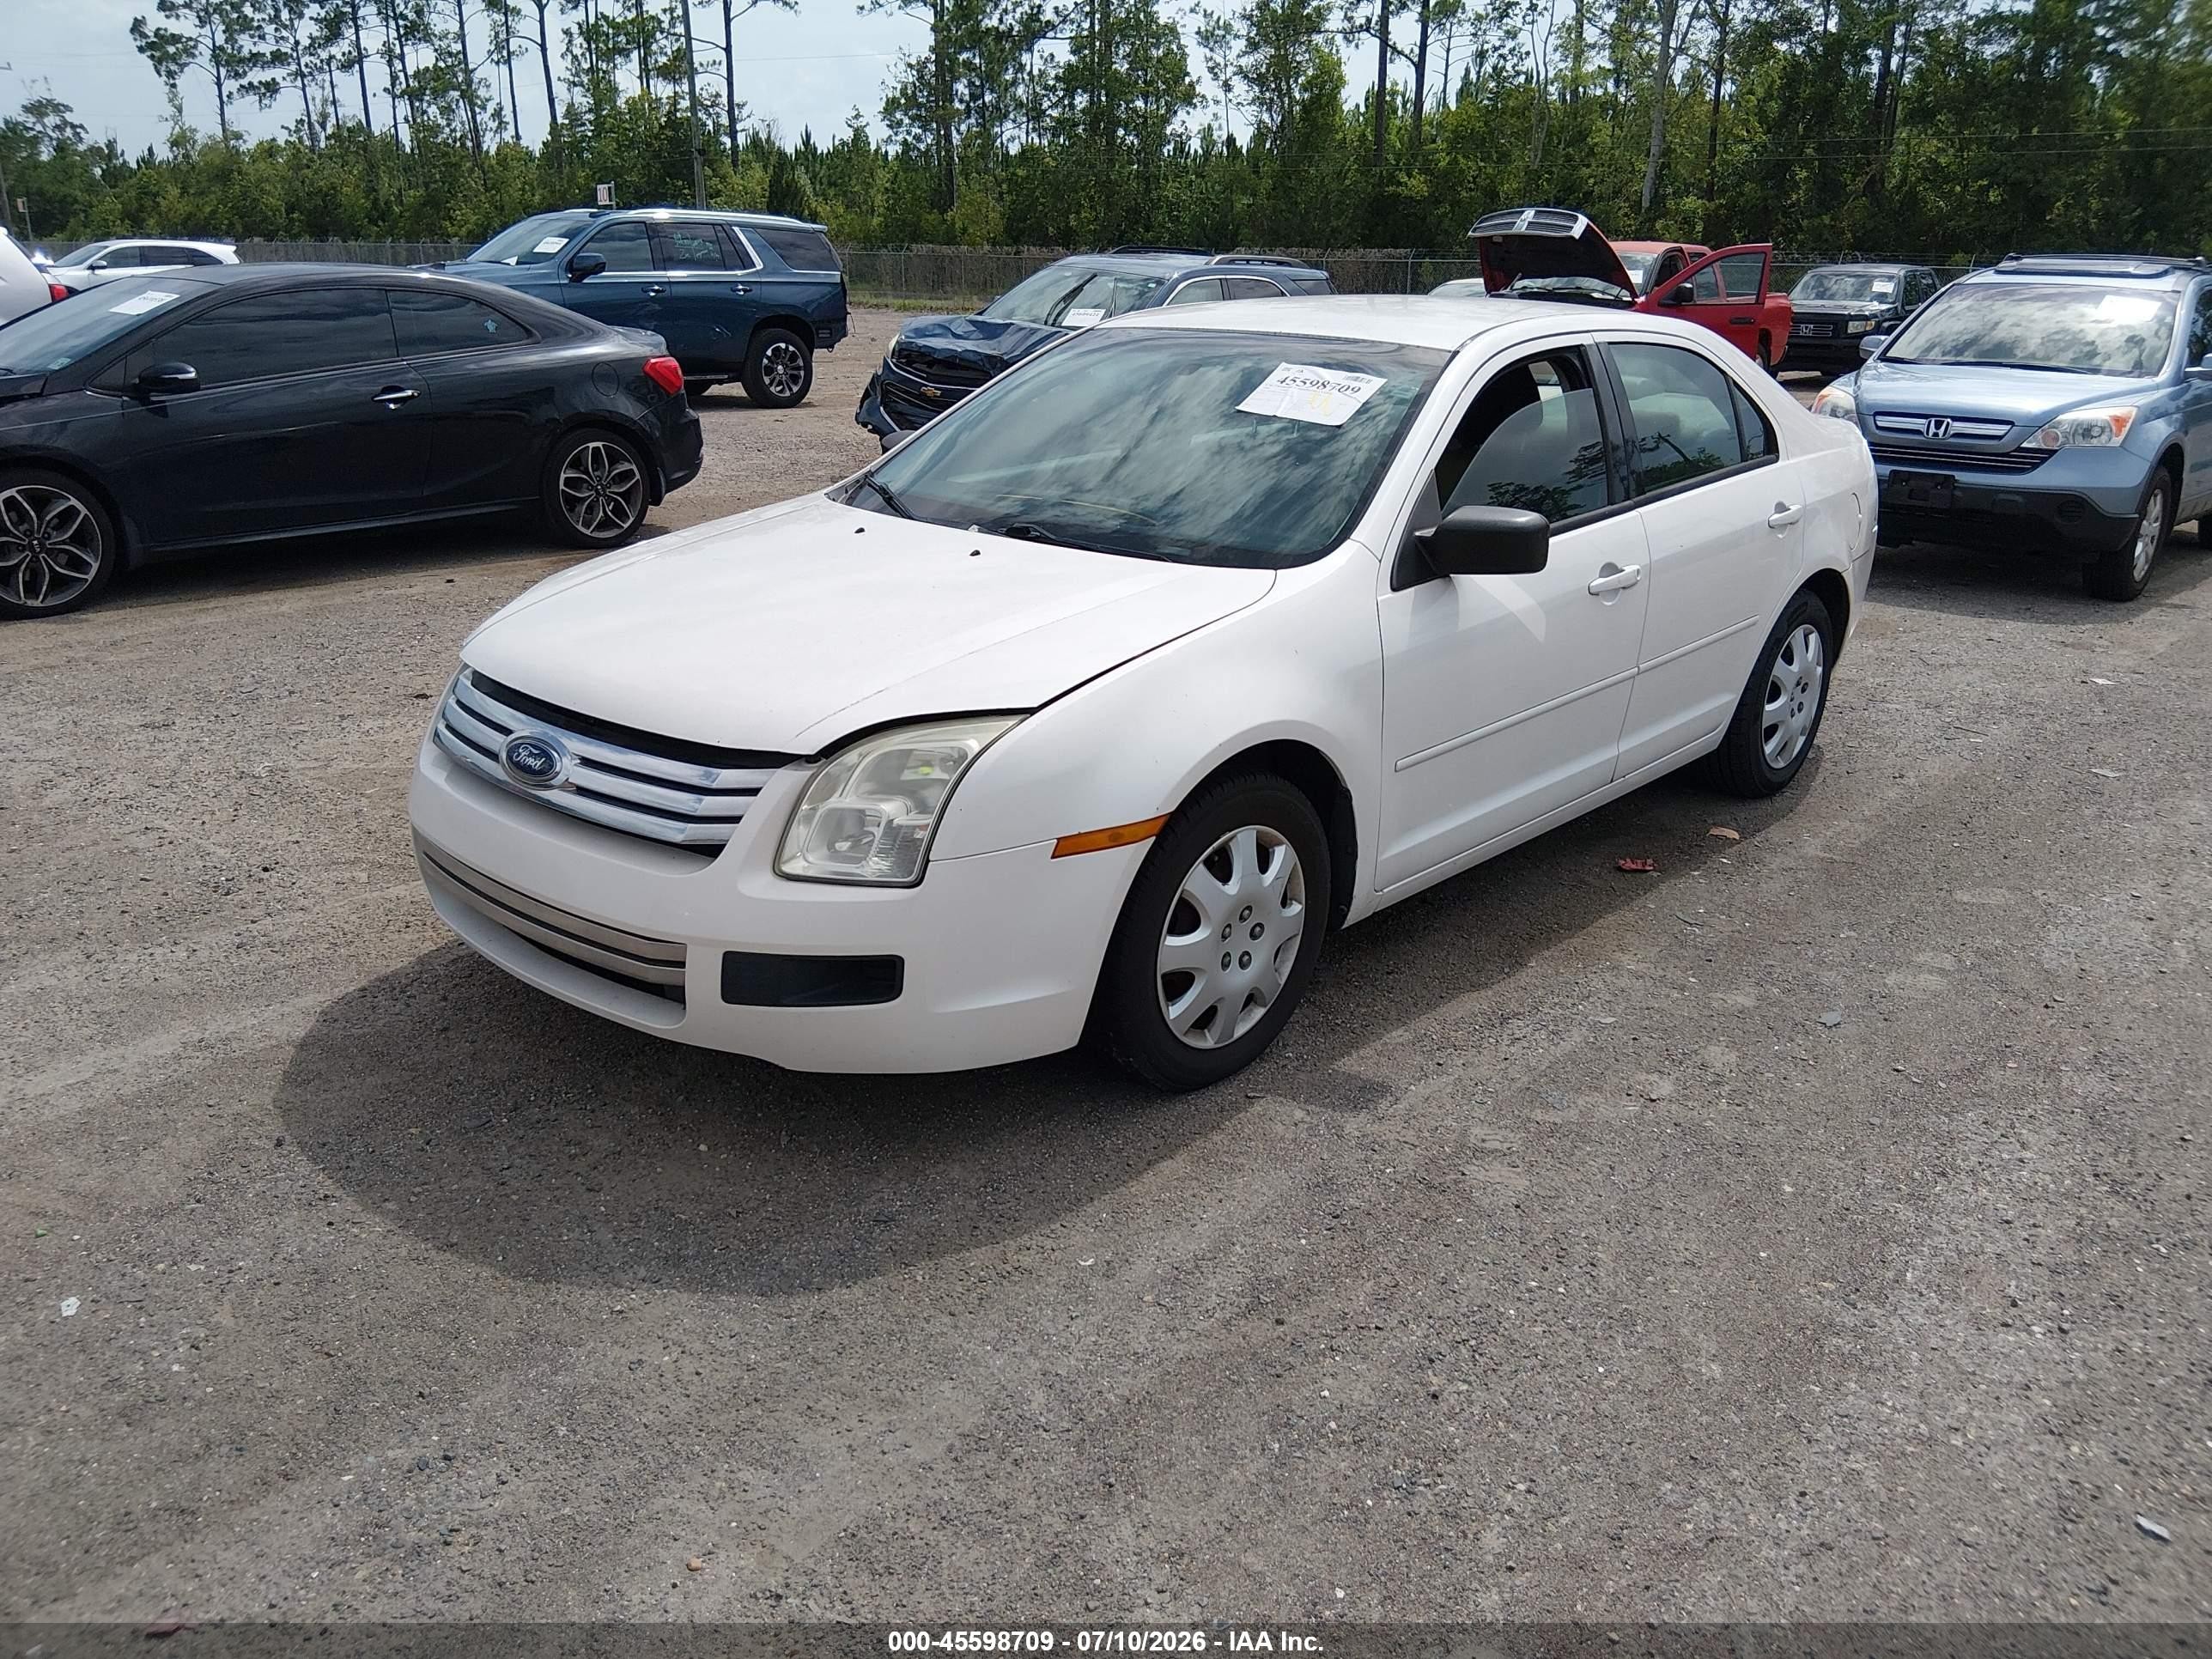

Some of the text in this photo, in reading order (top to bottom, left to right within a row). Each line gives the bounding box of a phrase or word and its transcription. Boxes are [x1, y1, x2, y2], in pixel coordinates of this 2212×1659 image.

[598, 186, 608, 203] 10
[1277, 375, 1362, 394] 45598709
[513, 744, 547, 771] Ford
